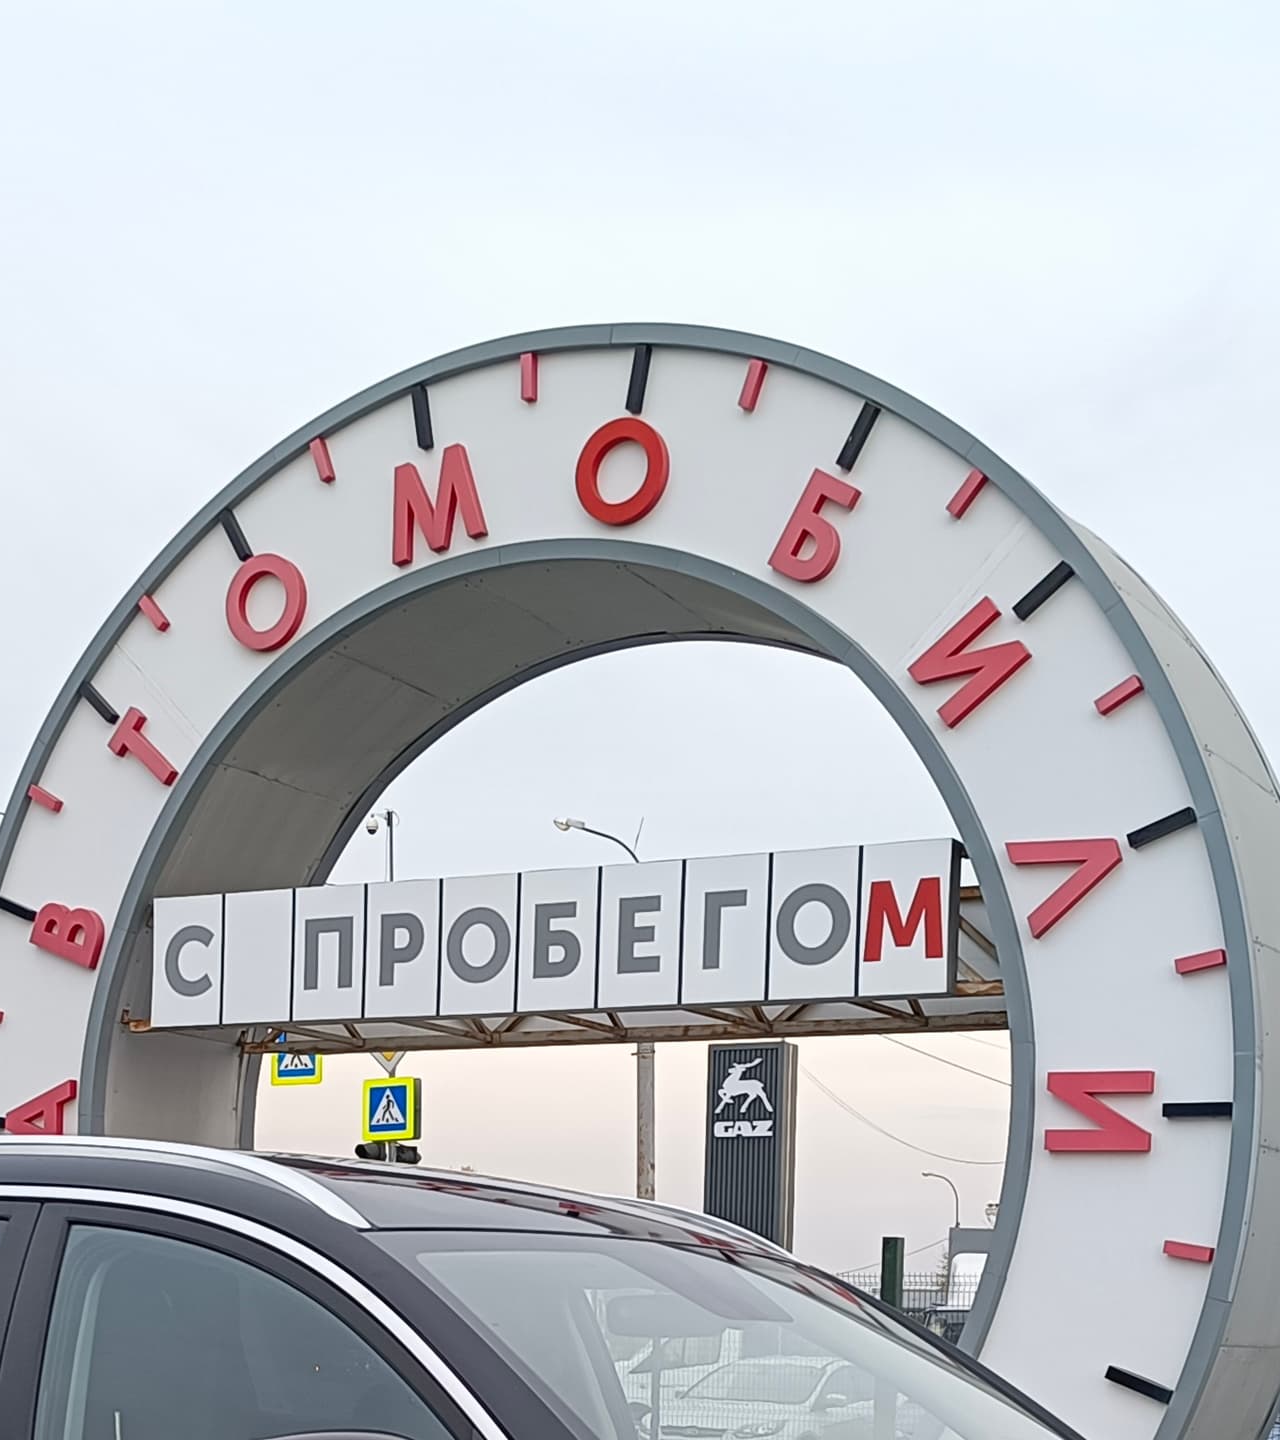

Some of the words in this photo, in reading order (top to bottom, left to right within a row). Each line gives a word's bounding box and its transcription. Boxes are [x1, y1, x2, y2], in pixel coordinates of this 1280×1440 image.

[164, 925, 213, 997] С
[303, 877, 944, 991] ПРОБЕГОМ
[714, 1120, 773, 1137] GAZ
